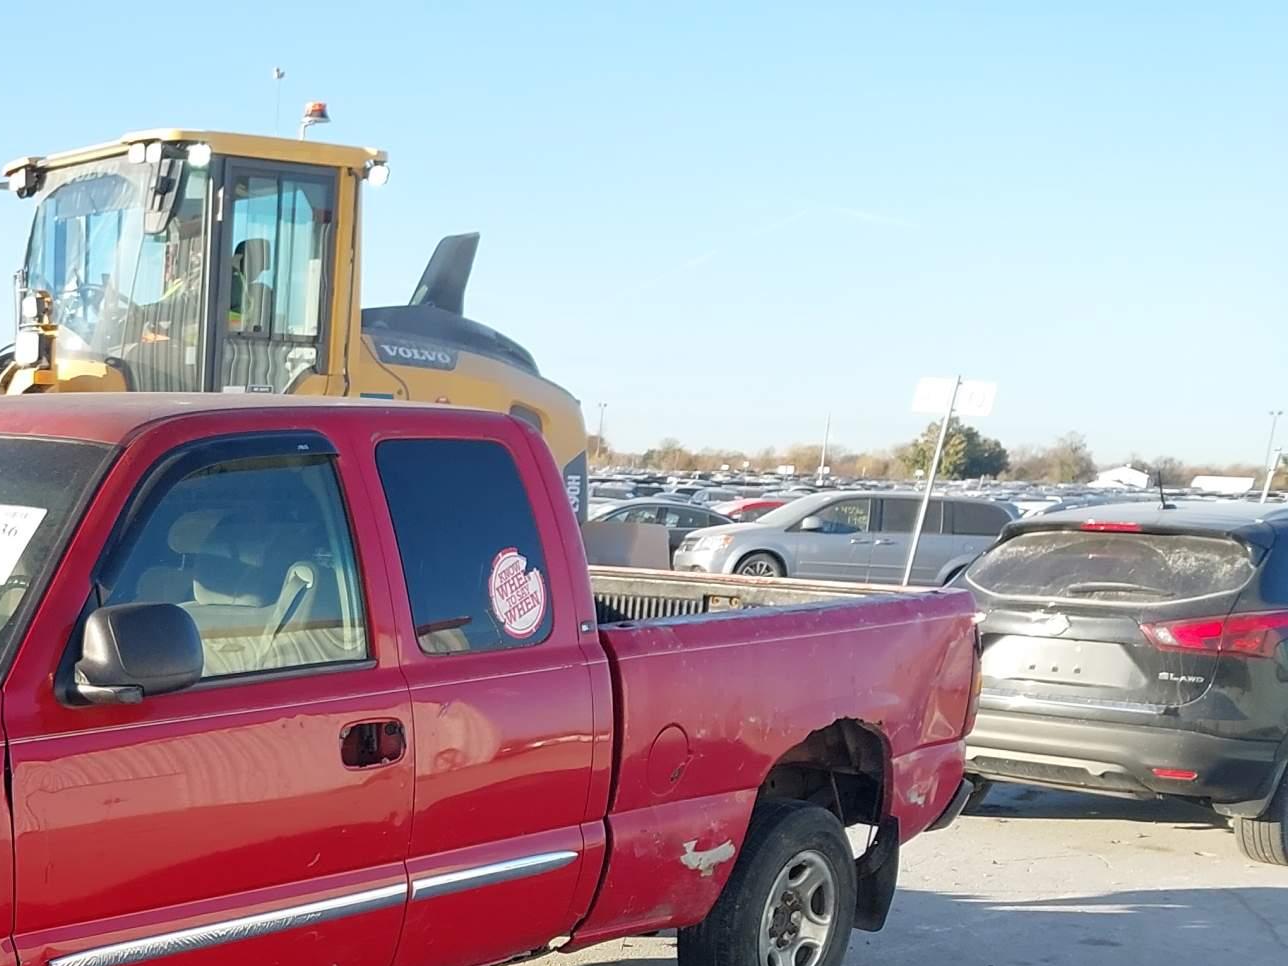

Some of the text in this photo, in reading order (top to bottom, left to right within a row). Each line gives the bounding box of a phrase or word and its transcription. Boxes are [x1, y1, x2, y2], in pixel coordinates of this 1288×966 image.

[380, 344, 451, 363] VOLVO
[498, 560, 521, 583] KNOW
[504, 591, 540, 625] WHEN
